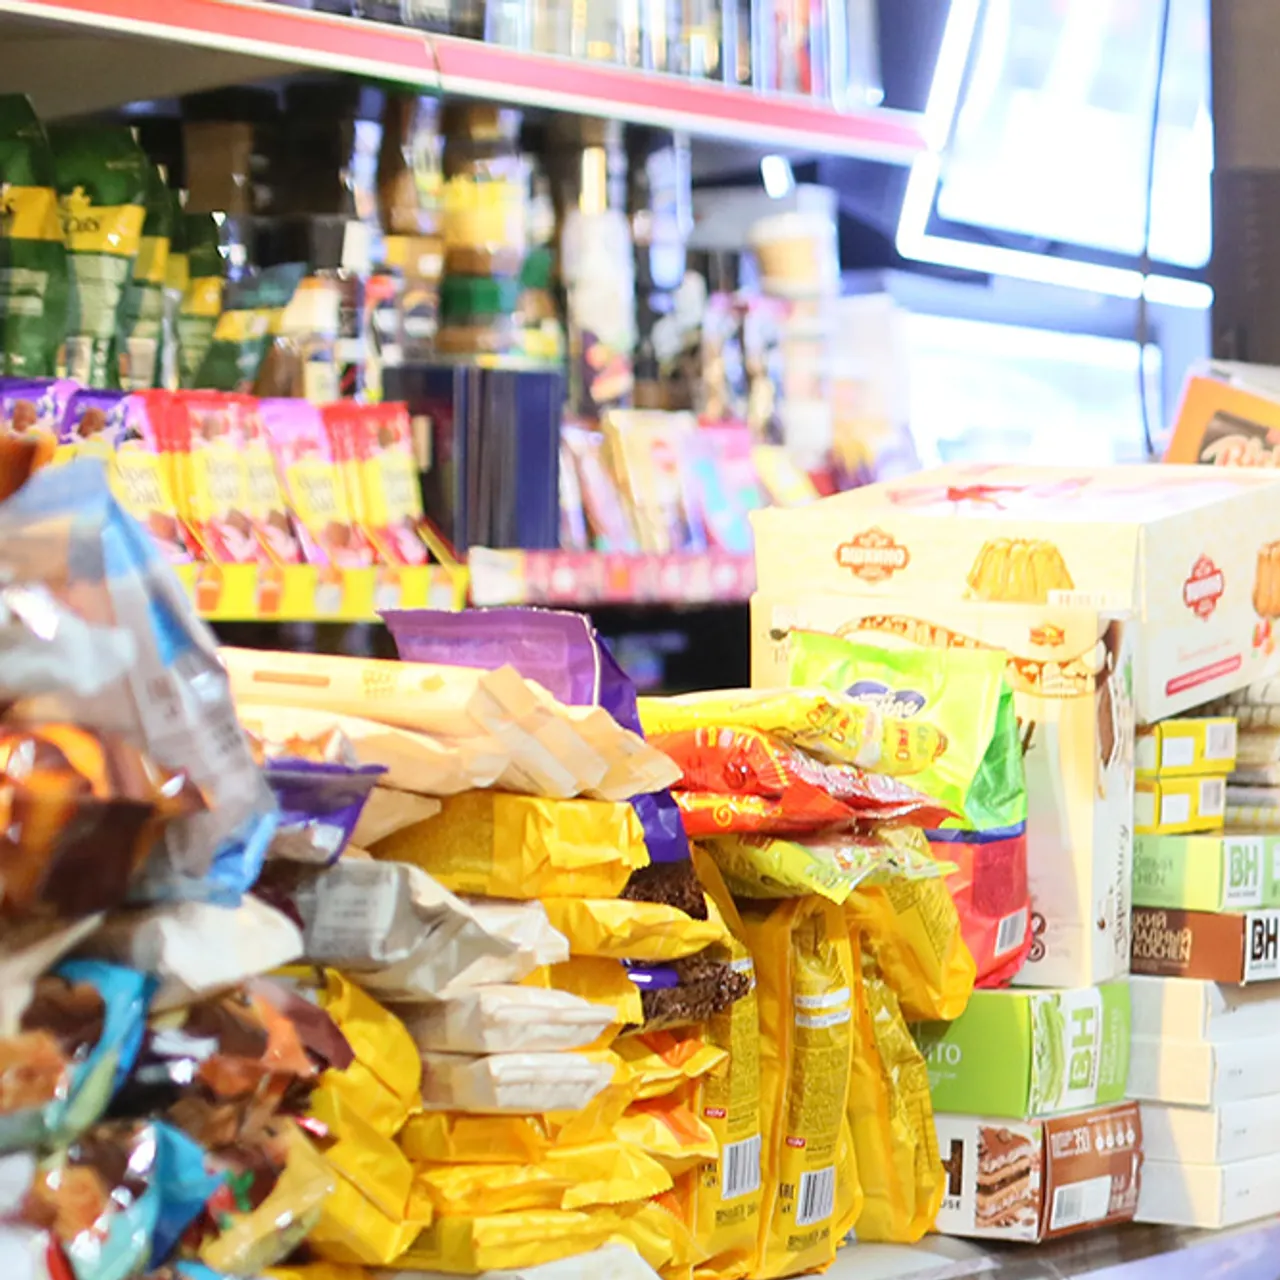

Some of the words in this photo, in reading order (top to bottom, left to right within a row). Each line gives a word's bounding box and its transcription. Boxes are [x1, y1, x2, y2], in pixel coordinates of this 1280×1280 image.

[1229, 845, 1259, 888] BH
[1133, 927, 1193, 948] ЛАДНЫЙ
[1250, 917, 1279, 961] BH
[920, 1042, 962, 1066] ИТО
[1068, 1006, 1095, 1090] BH
